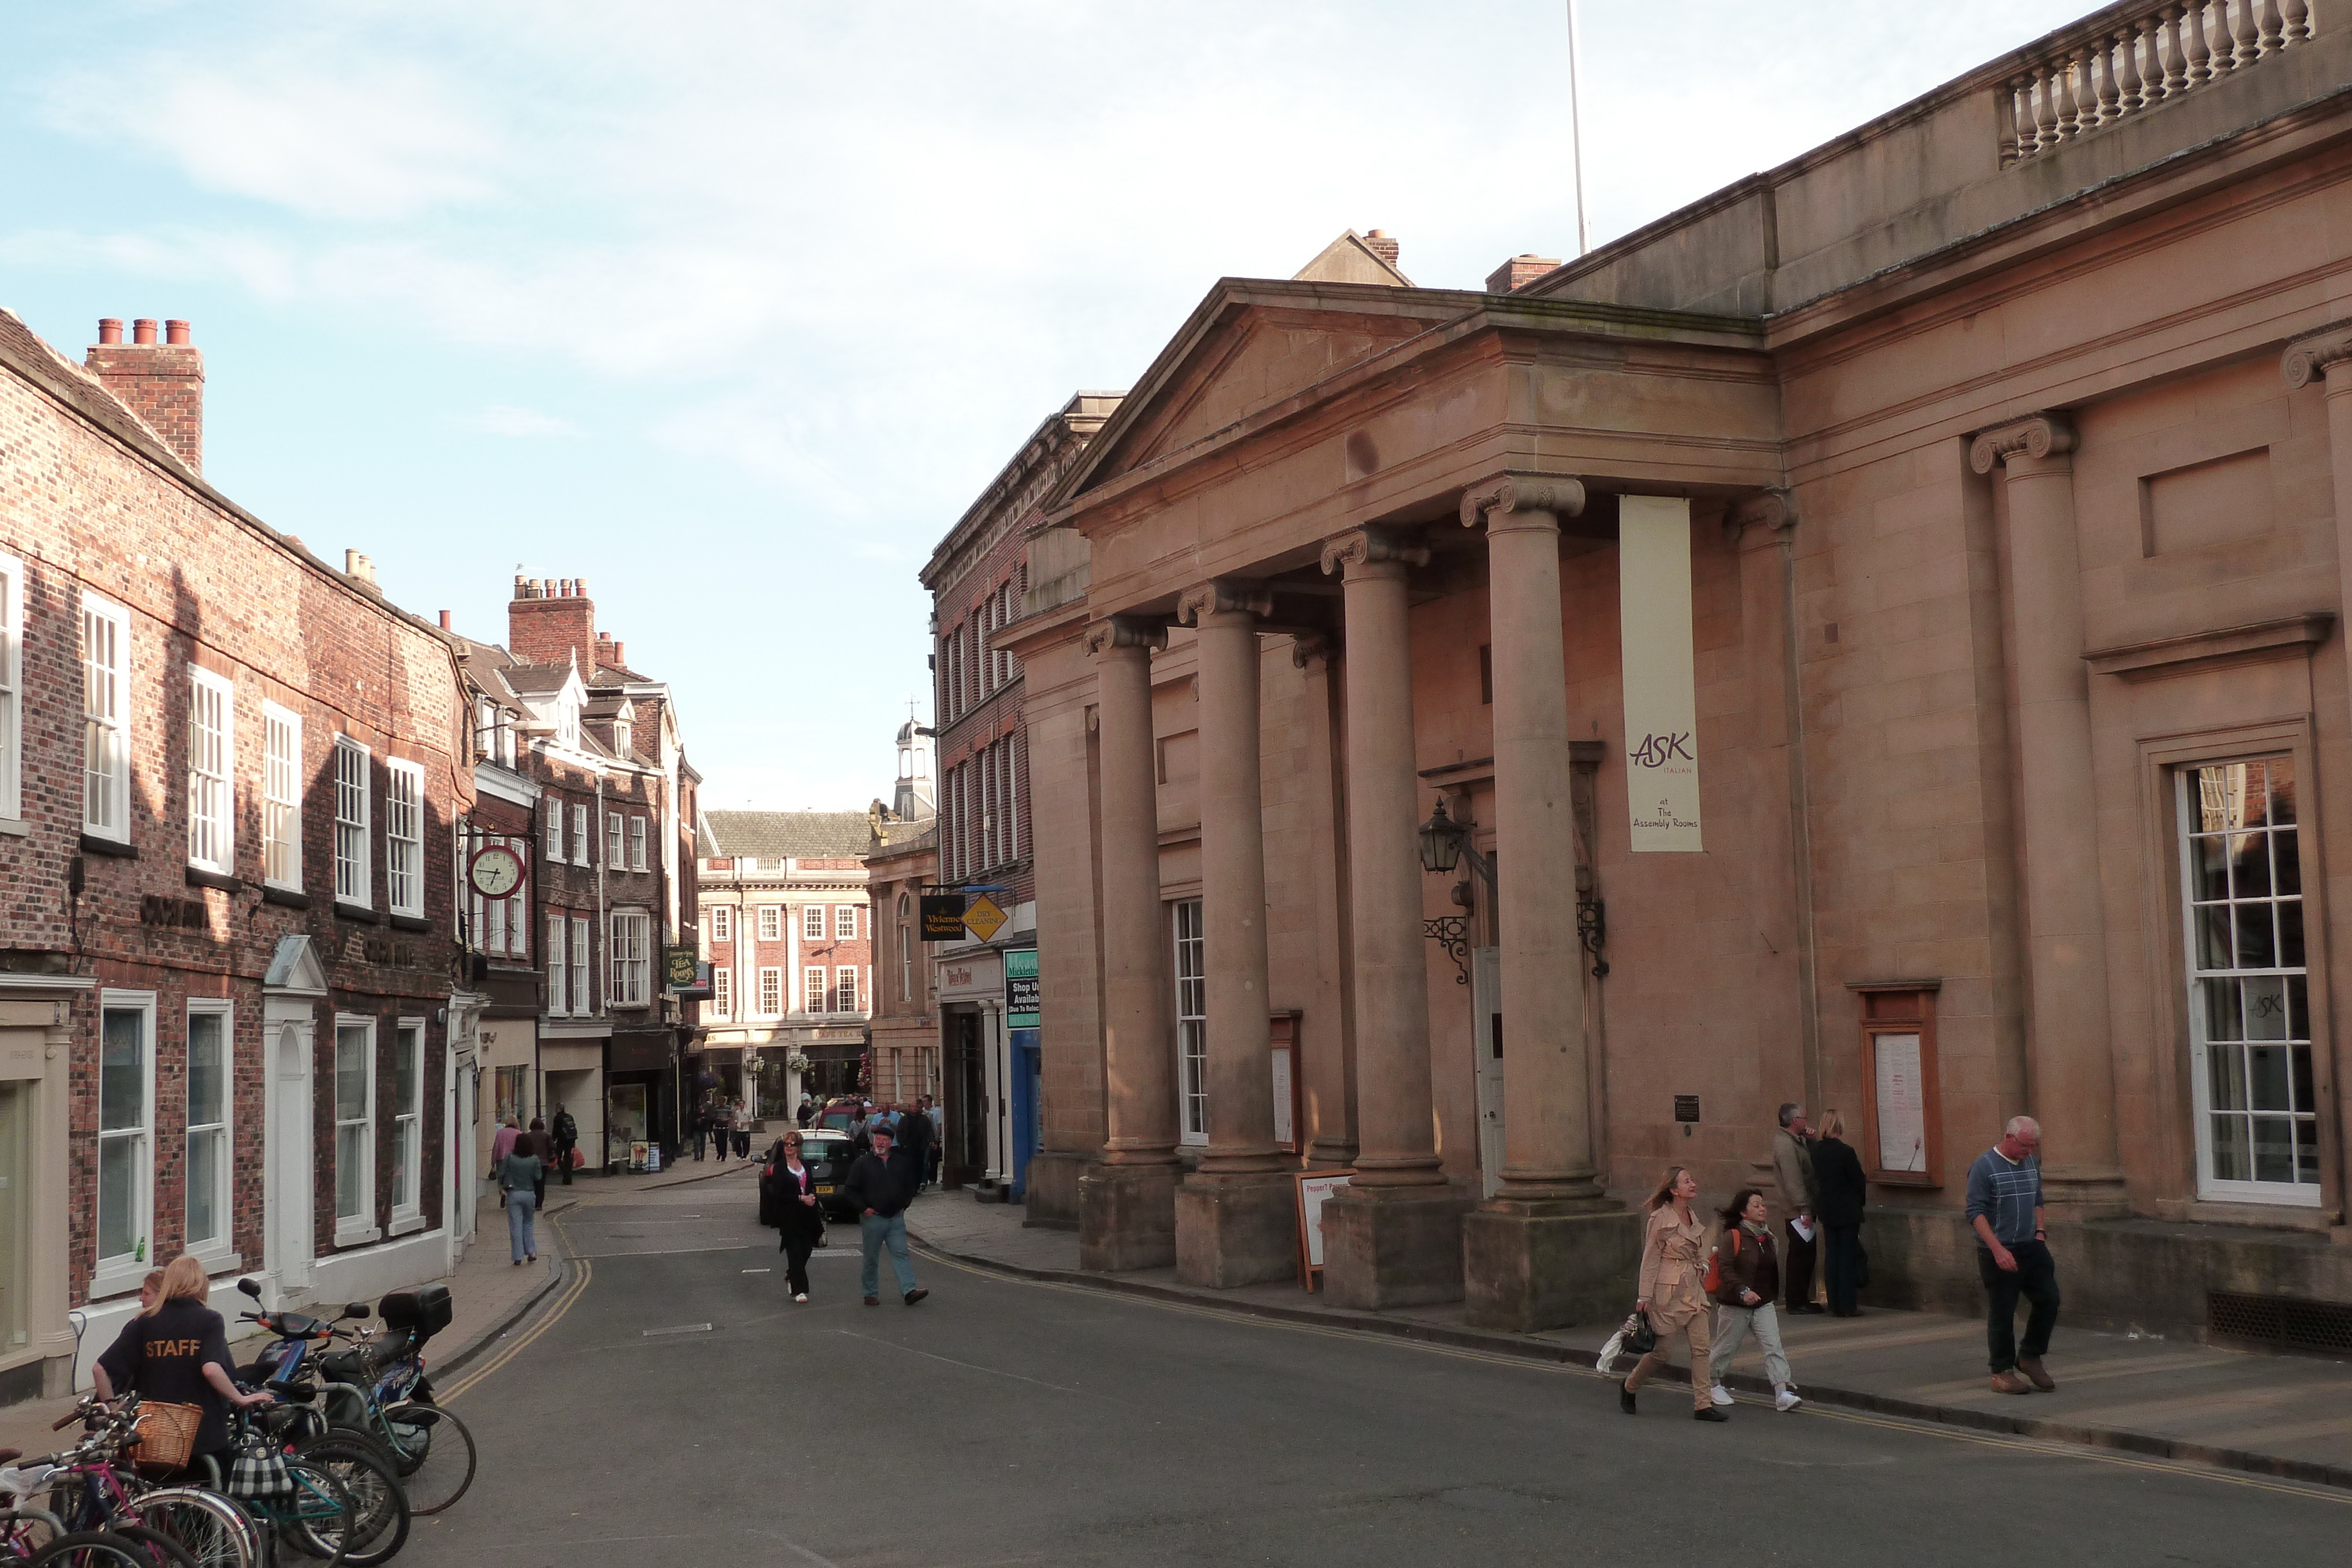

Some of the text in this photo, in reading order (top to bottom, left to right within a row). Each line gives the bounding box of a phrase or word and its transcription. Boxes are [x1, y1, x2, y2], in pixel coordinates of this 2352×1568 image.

[1629, 731, 1694, 768] ASK
[1658, 808, 1672, 817] The
[1633, 818, 1698, 830] Assembly Rooms
[926, 914, 960, 923] Vivienne
[925, 924, 963, 932] Westwood
[671, 958, 691, 969] TEA
[670, 967, 694, 979] ROOMS
[1013, 982, 1030, 994] Shop
[1014, 994, 1039, 1004] Availab
[2247, 994, 2283, 1018] ASK
[1307, 1183, 1328, 1193] Pepper?
[146, 1339, 201, 1358] STAFF
